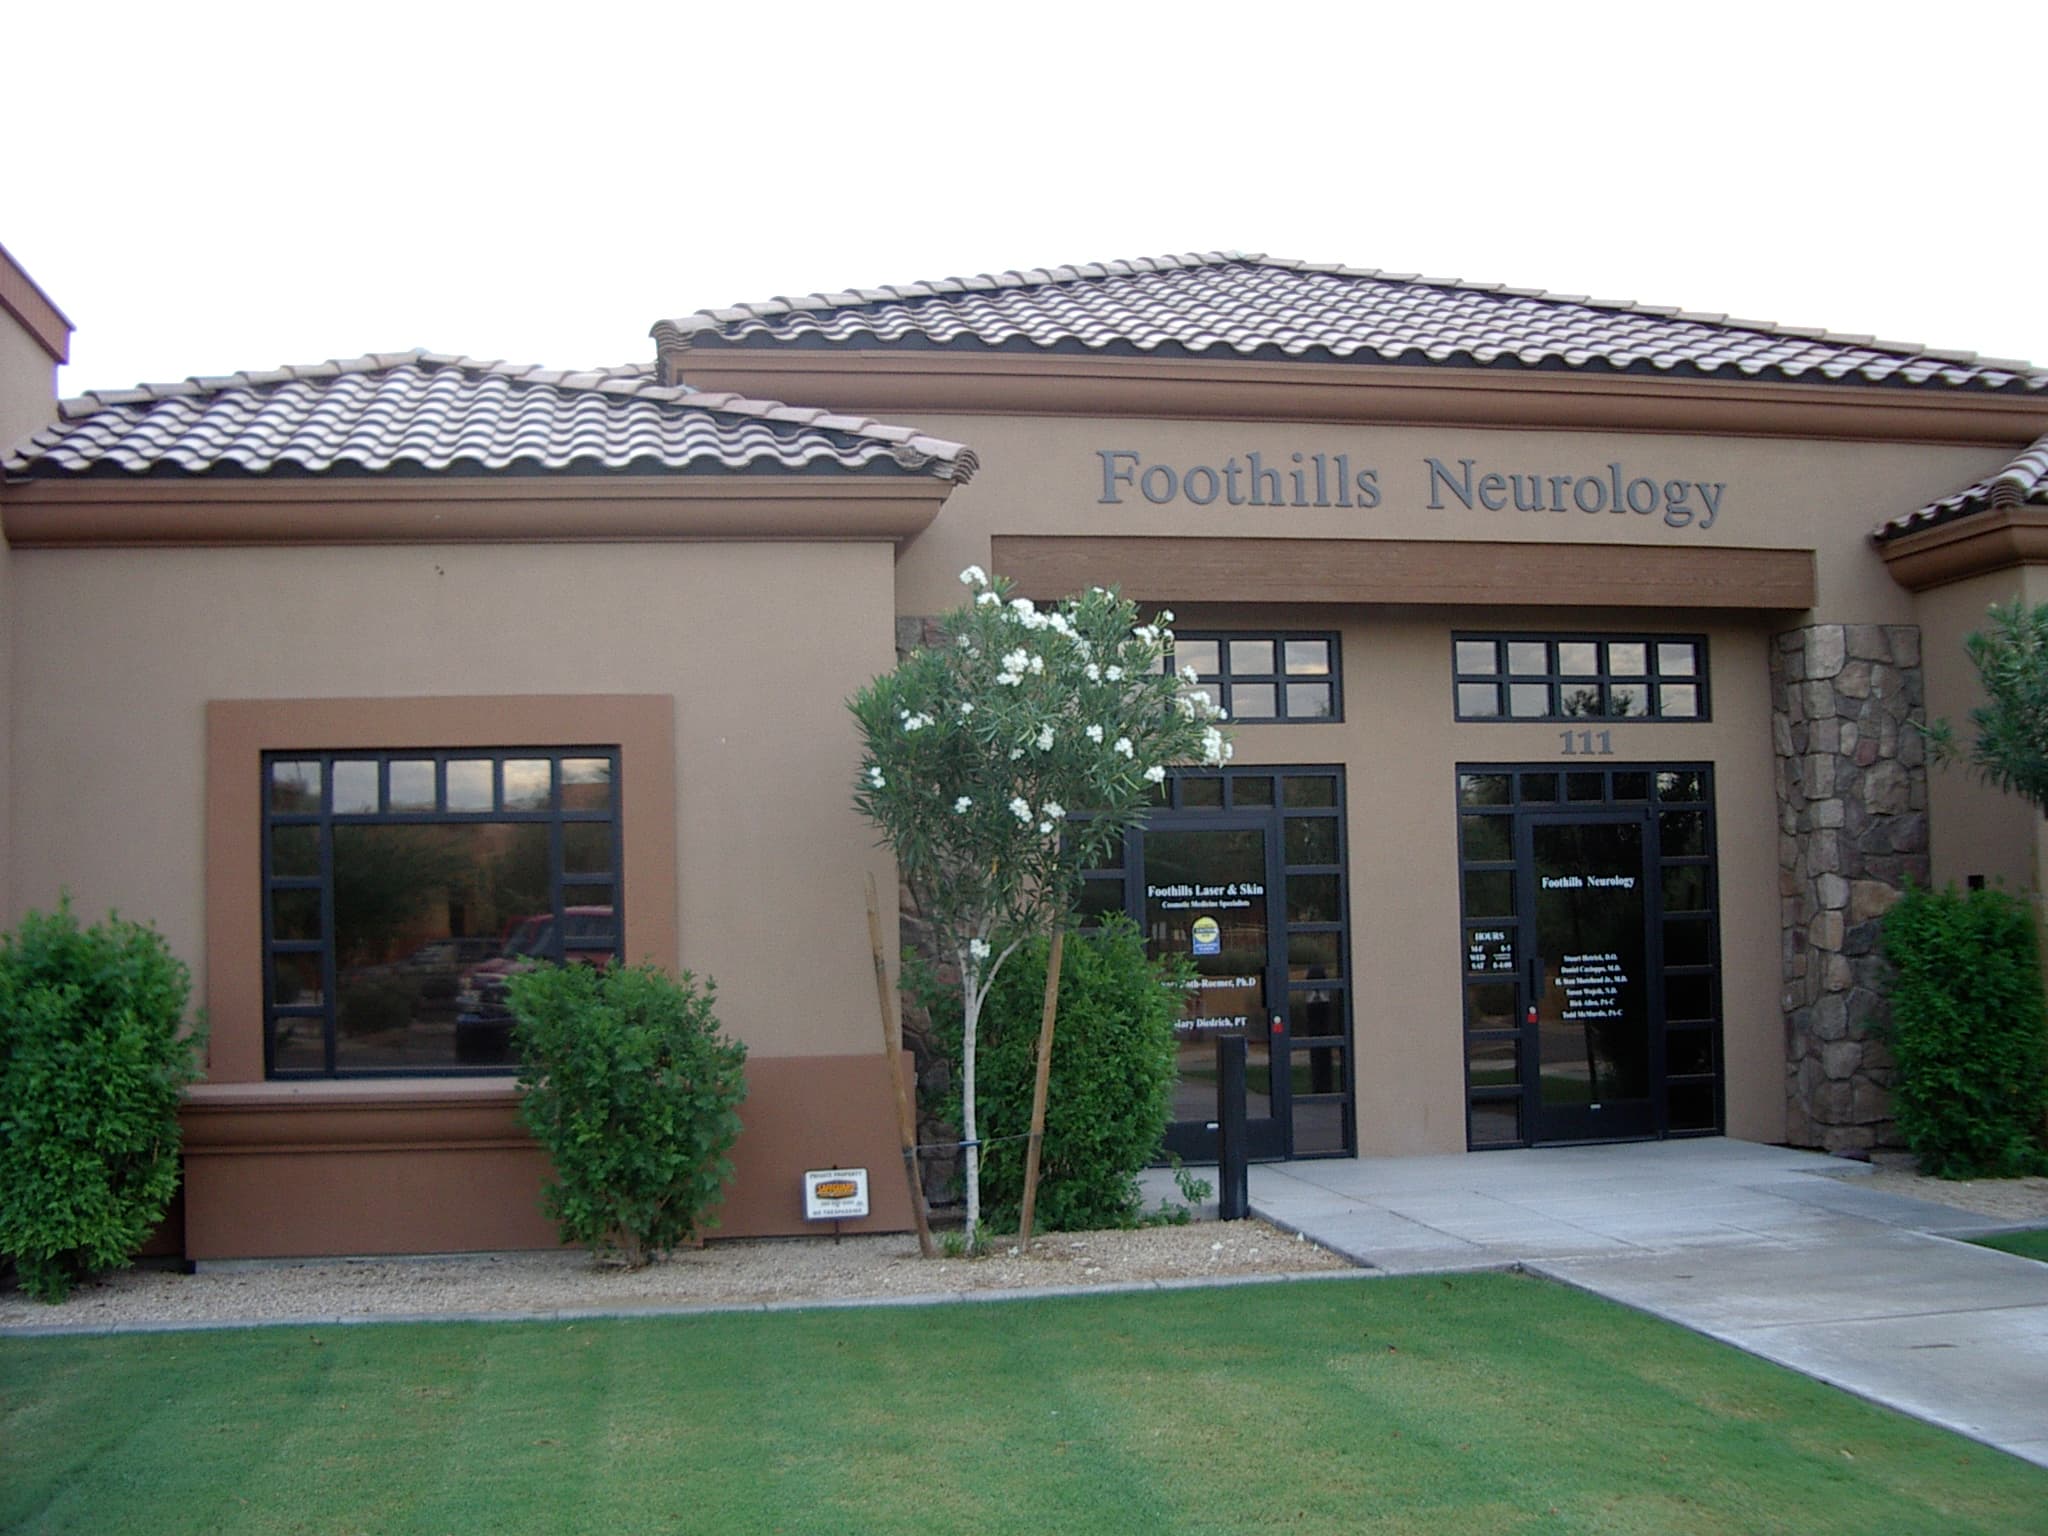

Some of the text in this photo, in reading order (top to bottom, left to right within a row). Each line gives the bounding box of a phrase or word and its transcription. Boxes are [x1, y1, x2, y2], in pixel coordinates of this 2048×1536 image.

[1096, 450, 1727, 528] Foothills Neurology
[1559, 730, 1614, 755] 111
[1542, 874, 1635, 889] Foothills Neurology
[1148, 883, 1264, 897] Foothills Laser & Skin
[1475, 931, 1505, 941] HOURS
[1235, 1016, 1247, 1027] PT
